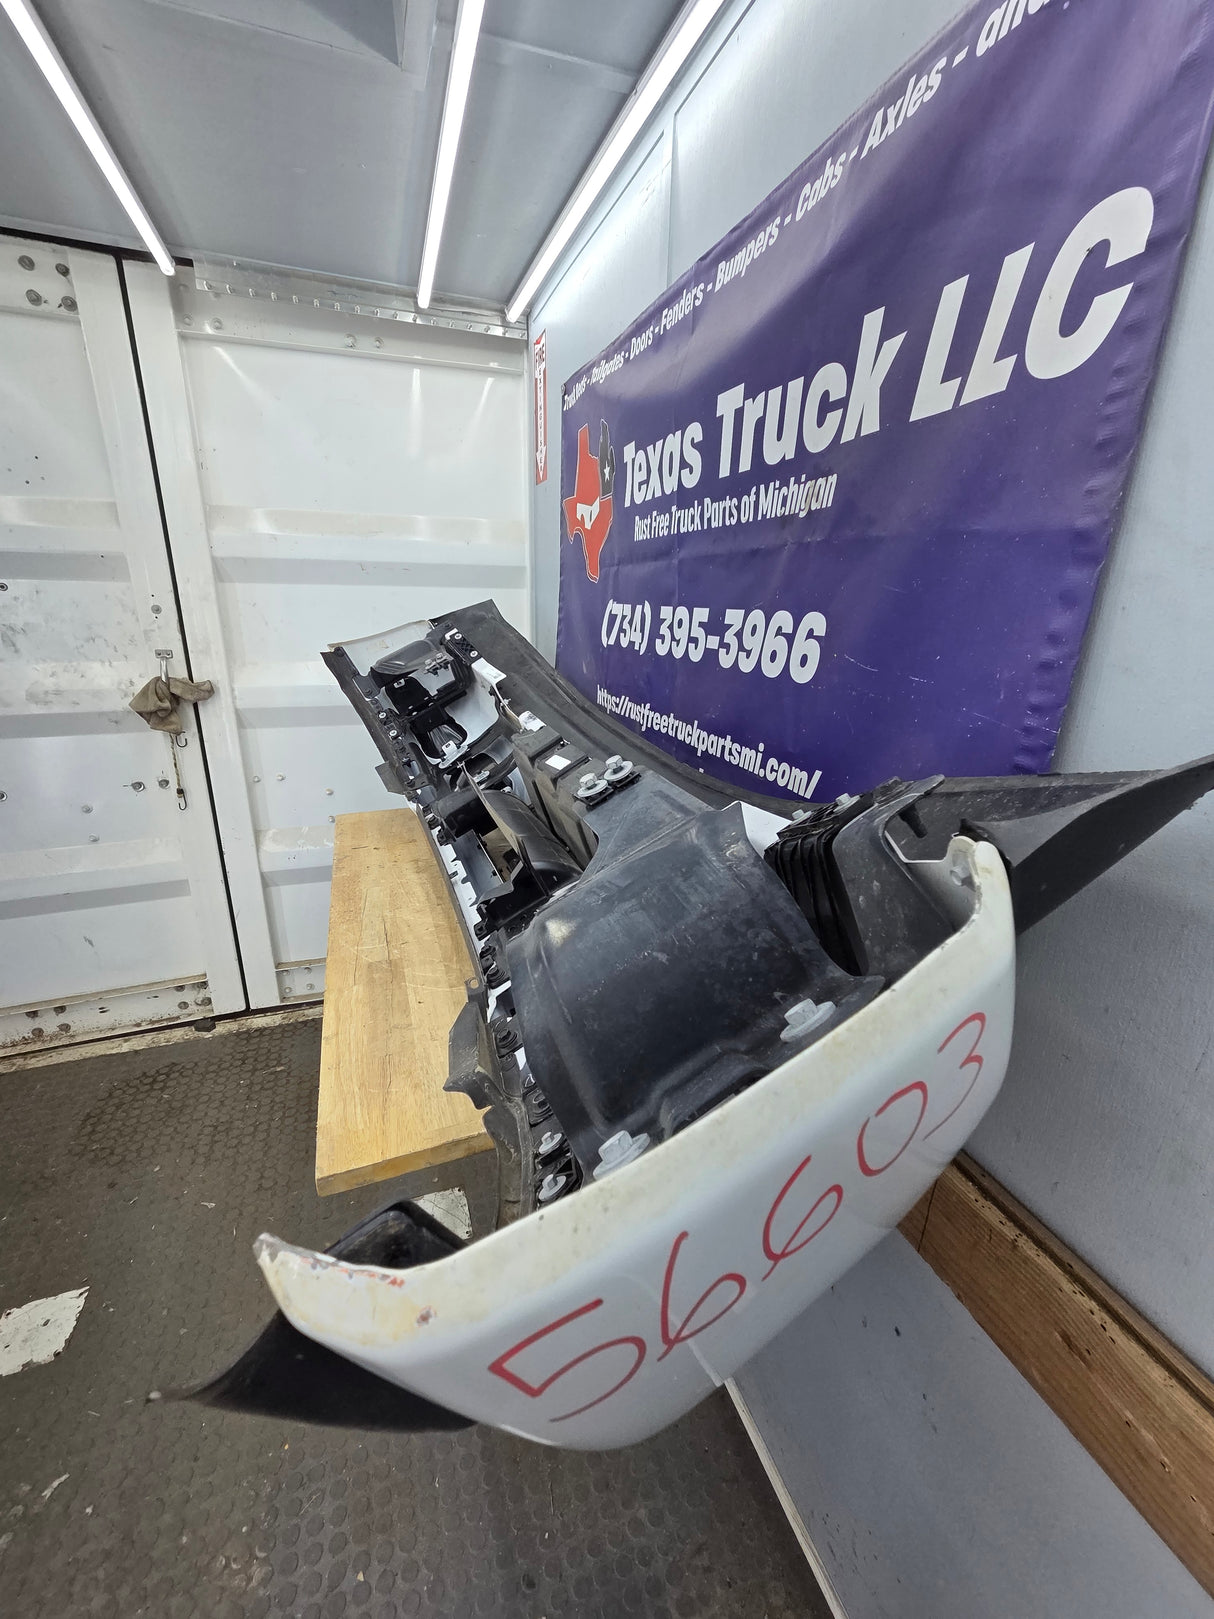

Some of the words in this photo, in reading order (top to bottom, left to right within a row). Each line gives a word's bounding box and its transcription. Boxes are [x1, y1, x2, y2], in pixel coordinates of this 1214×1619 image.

[563, 385, 576, 411] Truck
[590, 350, 624, 386] Tailgates
[630, 325, 654, 360] Doors
[660, 282, 704, 335] Fenders
[714, 216, 781, 293] Bumpers
[795, 152, 847, 221] Cabs
[860, 56, 948, 160] Axles
[976, 0, 1050, 57] an
[623, 421, 703, 508] Texas
[716, 306, 908, 479] Truck
[909, 186, 1155, 423] LLC
[634, 512, 651, 542] Rust
[651, 511, 669, 539] Free
[671, 500, 702, 535] Truck
[703, 495, 738, 530] Parts
[740, 486, 757, 523] of
[757, 473, 838, 521] Michigan
[596, 684, 823, 800] https://rustfreetruckpartsmi.com/
[601, 598, 652, 655] (734)
[655, 605, 827, 684] 395-3966
[487, 1011, 987, 1423] 56603
